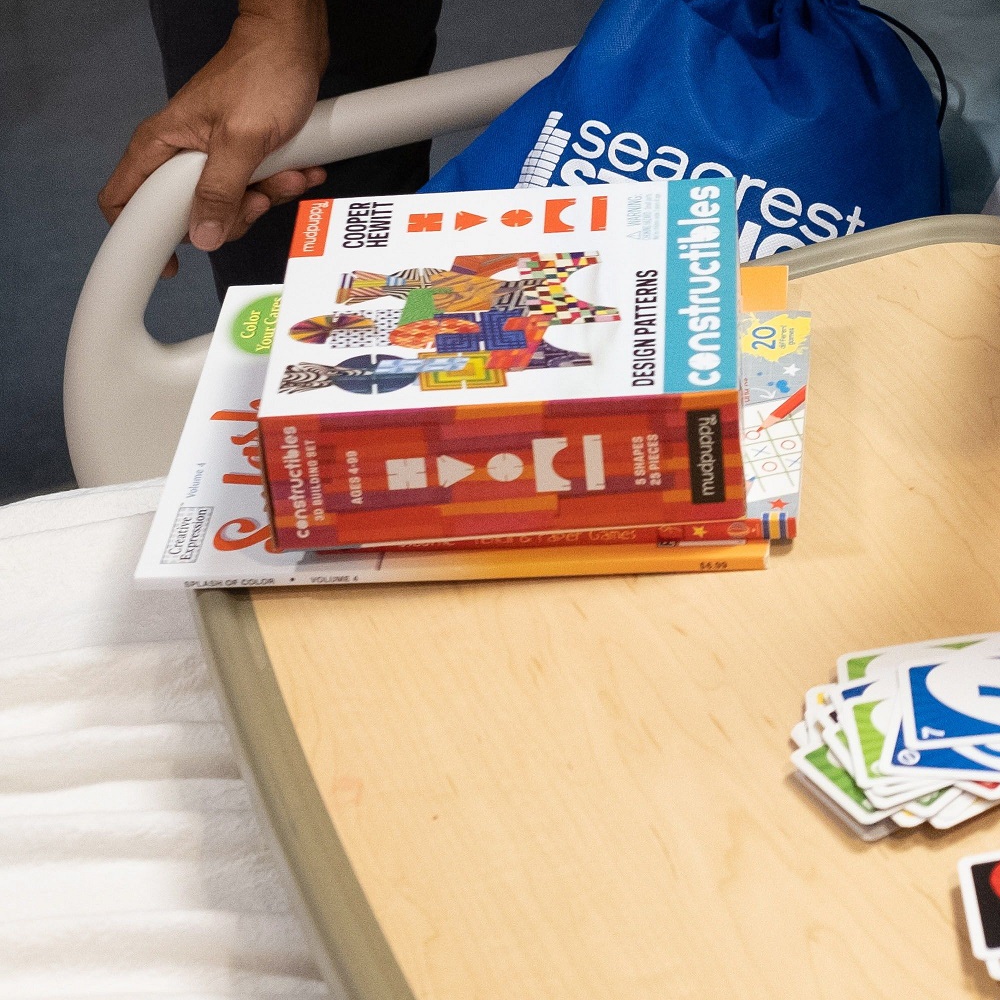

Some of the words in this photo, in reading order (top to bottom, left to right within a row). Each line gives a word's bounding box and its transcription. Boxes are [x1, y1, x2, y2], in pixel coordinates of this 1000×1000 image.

[303, 201, 330, 252] mudpuppy
[343, 202, 371, 248] COOPER
[366, 201, 394, 248] HEWITT
[635, 269, 658, 334] PATTERNS
[677, 184, 722, 387] constructibles
[240, 310, 261, 339] Color
[255, 327, 275, 351] Your
[751, 325, 777, 350] 20
[632, 338, 656, 388] DESIGN
[631, 436, 646, 477] SHAPES
[646, 434, 660, 471] PIECES
[698, 415, 717, 496] mudpuppy
[186, 470, 204, 499] Volume
[281, 426, 310, 538] constructibles
[348, 476, 363, 505] AGES
[168, 515, 193, 557] Creative
[180, 508, 207, 562] Expression
[184, 579, 223, 588] SPLASH
[225, 578, 238, 587] OF
[241, 577, 275, 586] COLOR
[311, 575, 350, 583] VOLUME
[921, 726, 945, 740] 7
